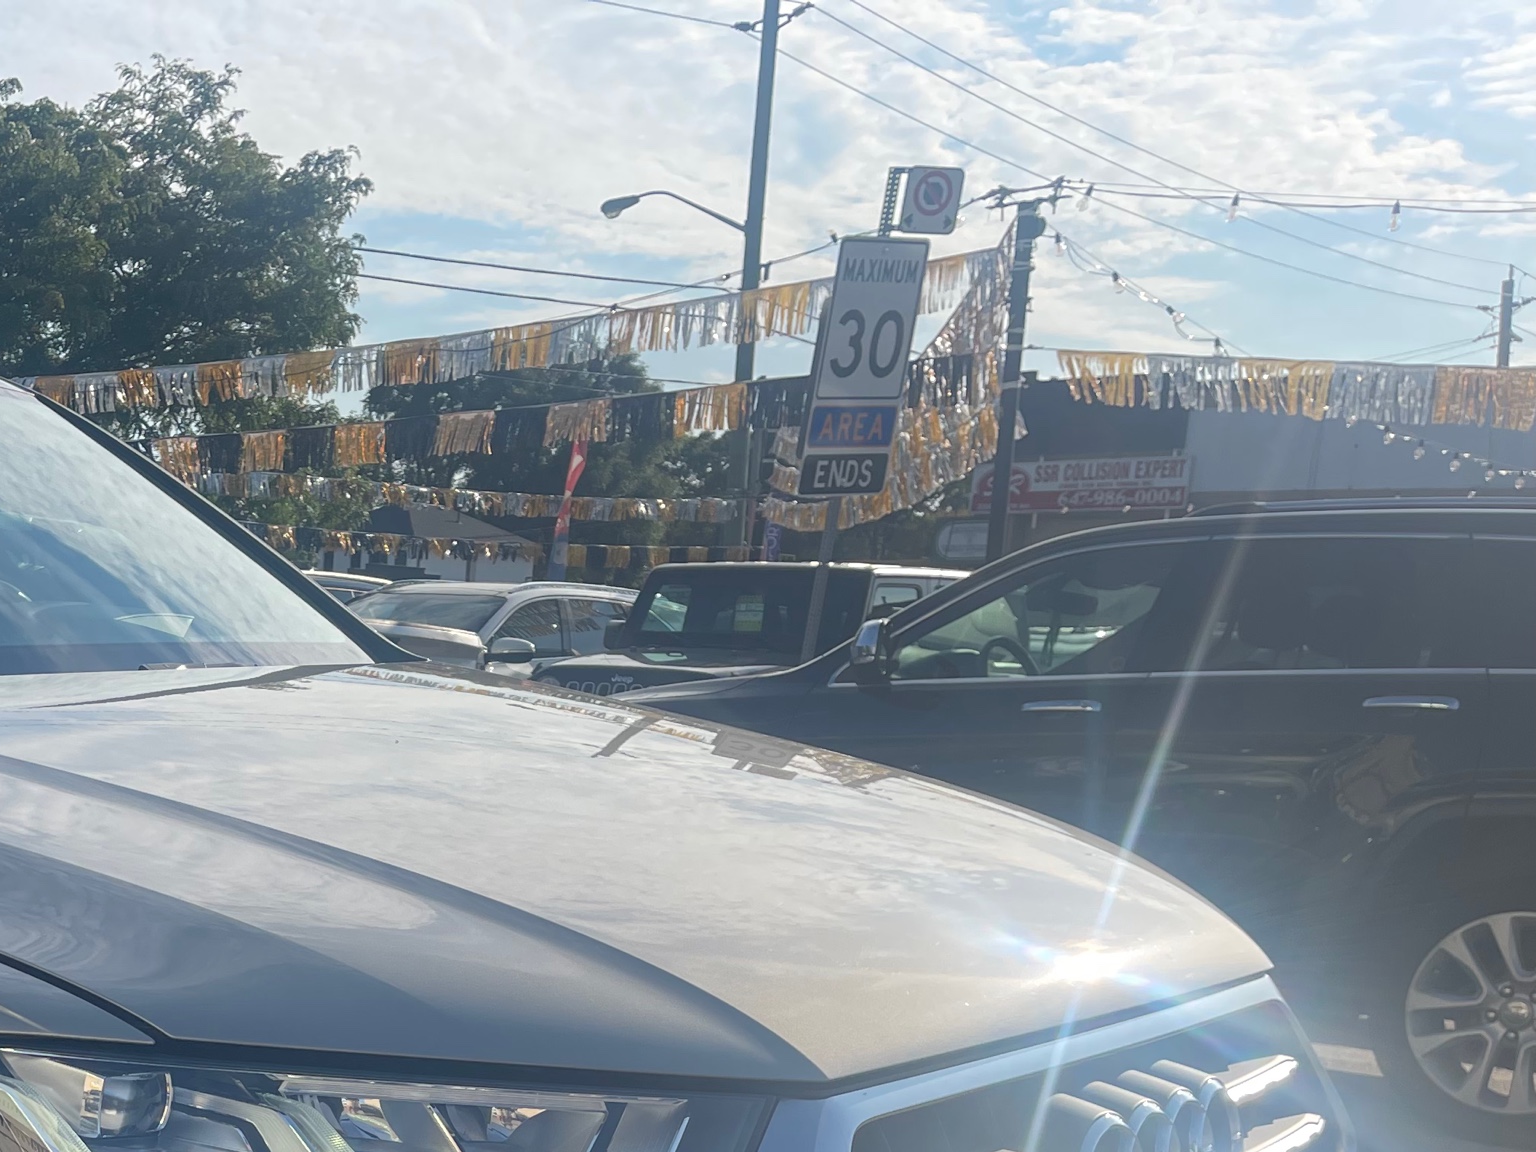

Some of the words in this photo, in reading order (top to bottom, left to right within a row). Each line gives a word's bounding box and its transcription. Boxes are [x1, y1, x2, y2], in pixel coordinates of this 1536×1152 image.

[842, 258, 920, 283] MAXIMUM
[829, 309, 905, 379] 30
[819, 413, 883, 442] AREA
[813, 459, 874, 489] ENDS
[1034, 463, 1059, 484] SSR
[1063, 460, 1130, 482] COLLISION
[1134, 458, 1186, 479] EXPERT
[1056, 487, 1182, 507] 647-986-0004
